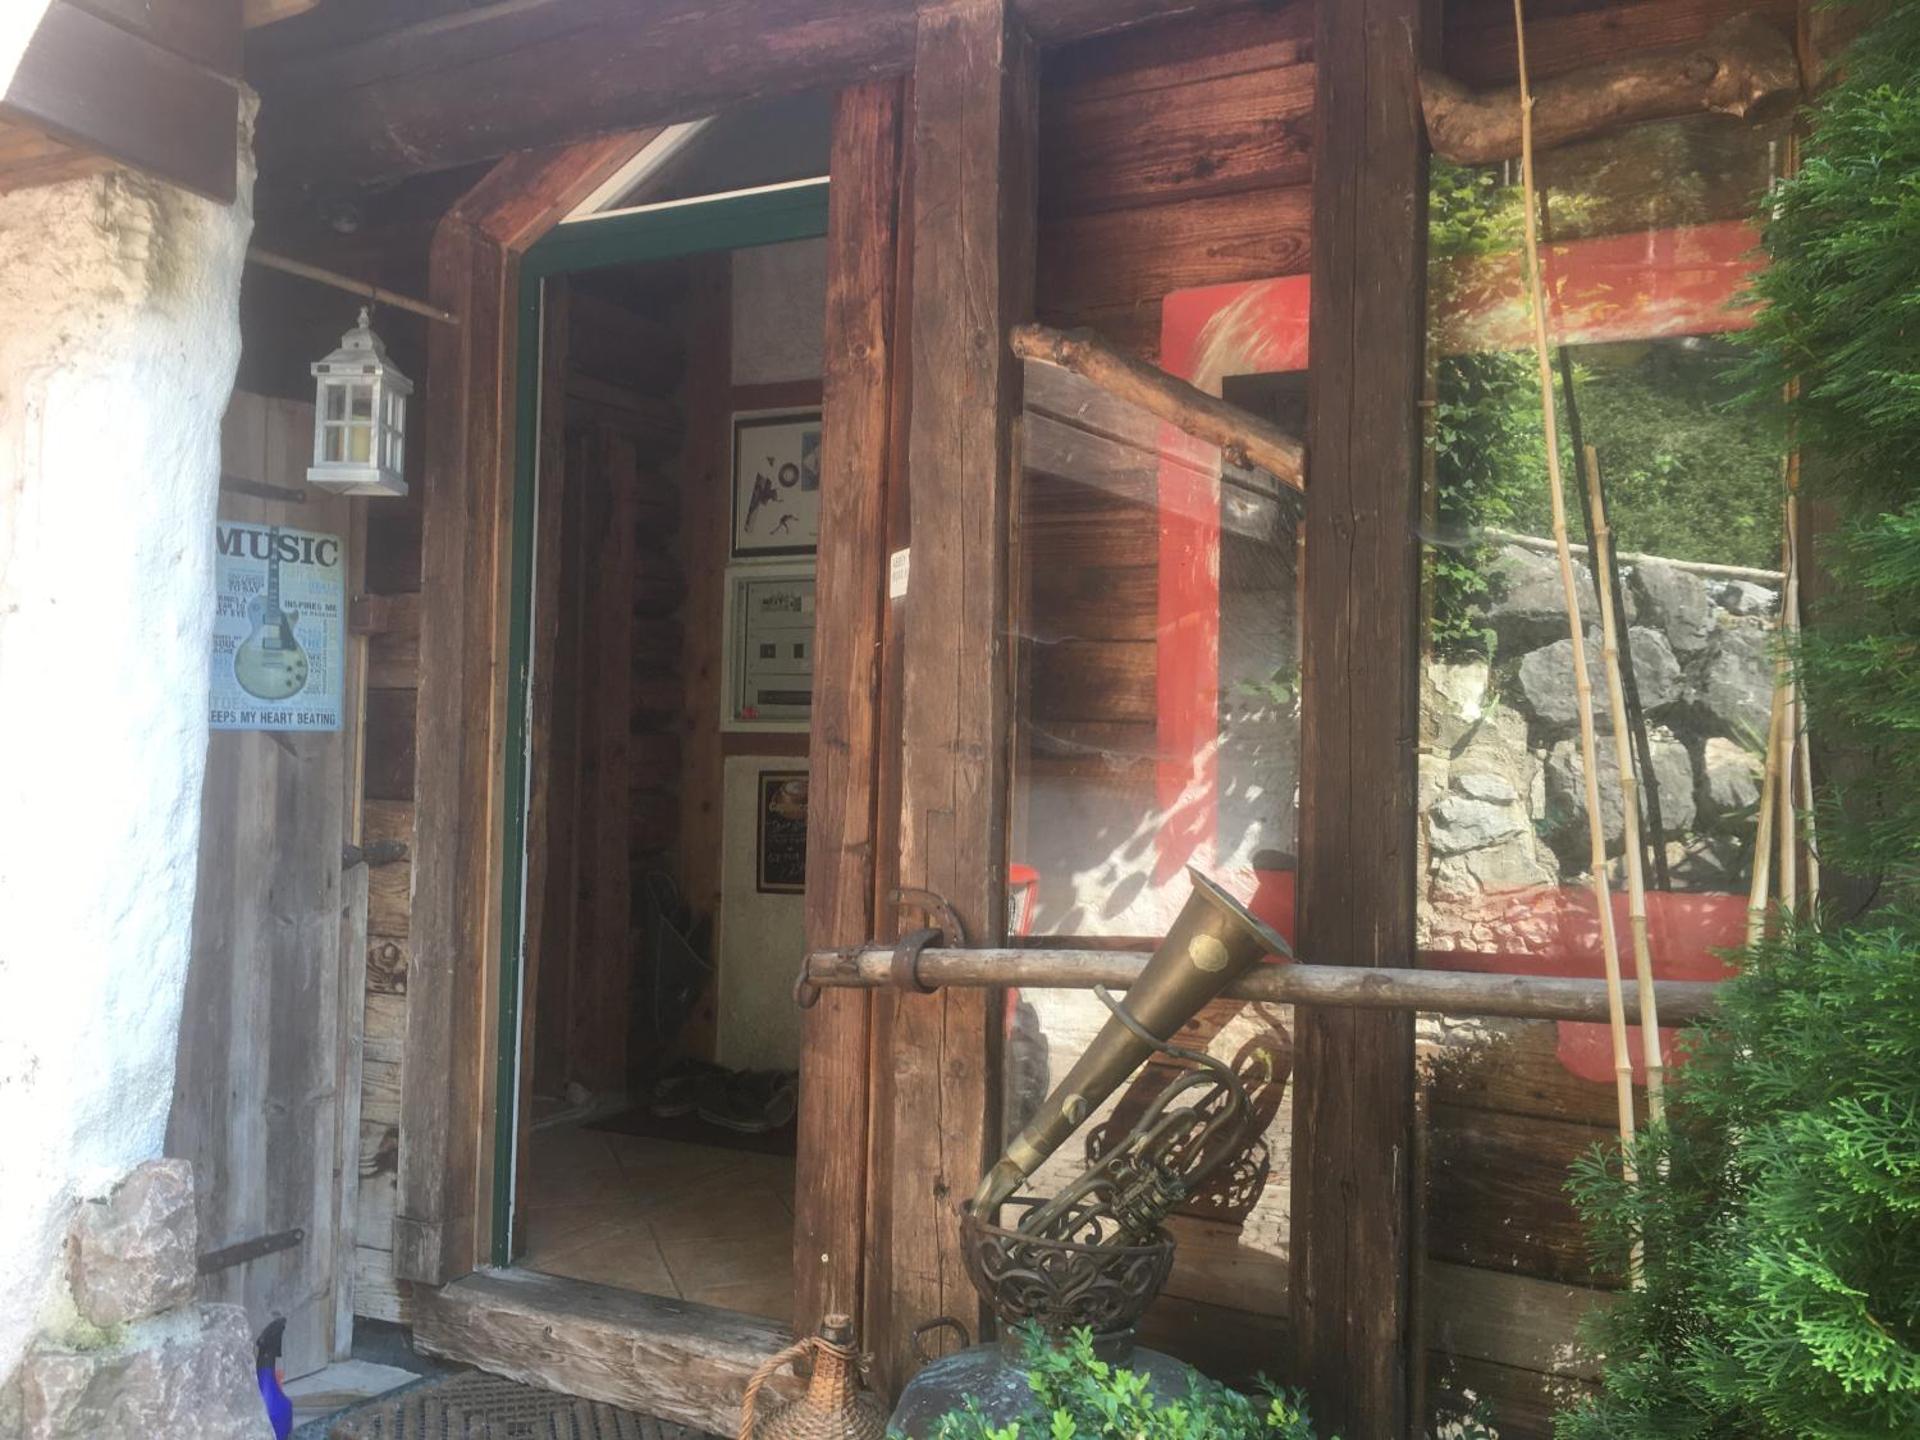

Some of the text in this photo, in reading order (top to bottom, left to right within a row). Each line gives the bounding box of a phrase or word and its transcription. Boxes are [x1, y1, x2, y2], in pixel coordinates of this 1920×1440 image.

[216, 526, 338, 567] MUSIC
[284, 599, 337, 612] INSPIRES ME
[240, 711, 257, 723] MY
[260, 711, 293, 724] HEART
[297, 712, 336, 726] BEATING
